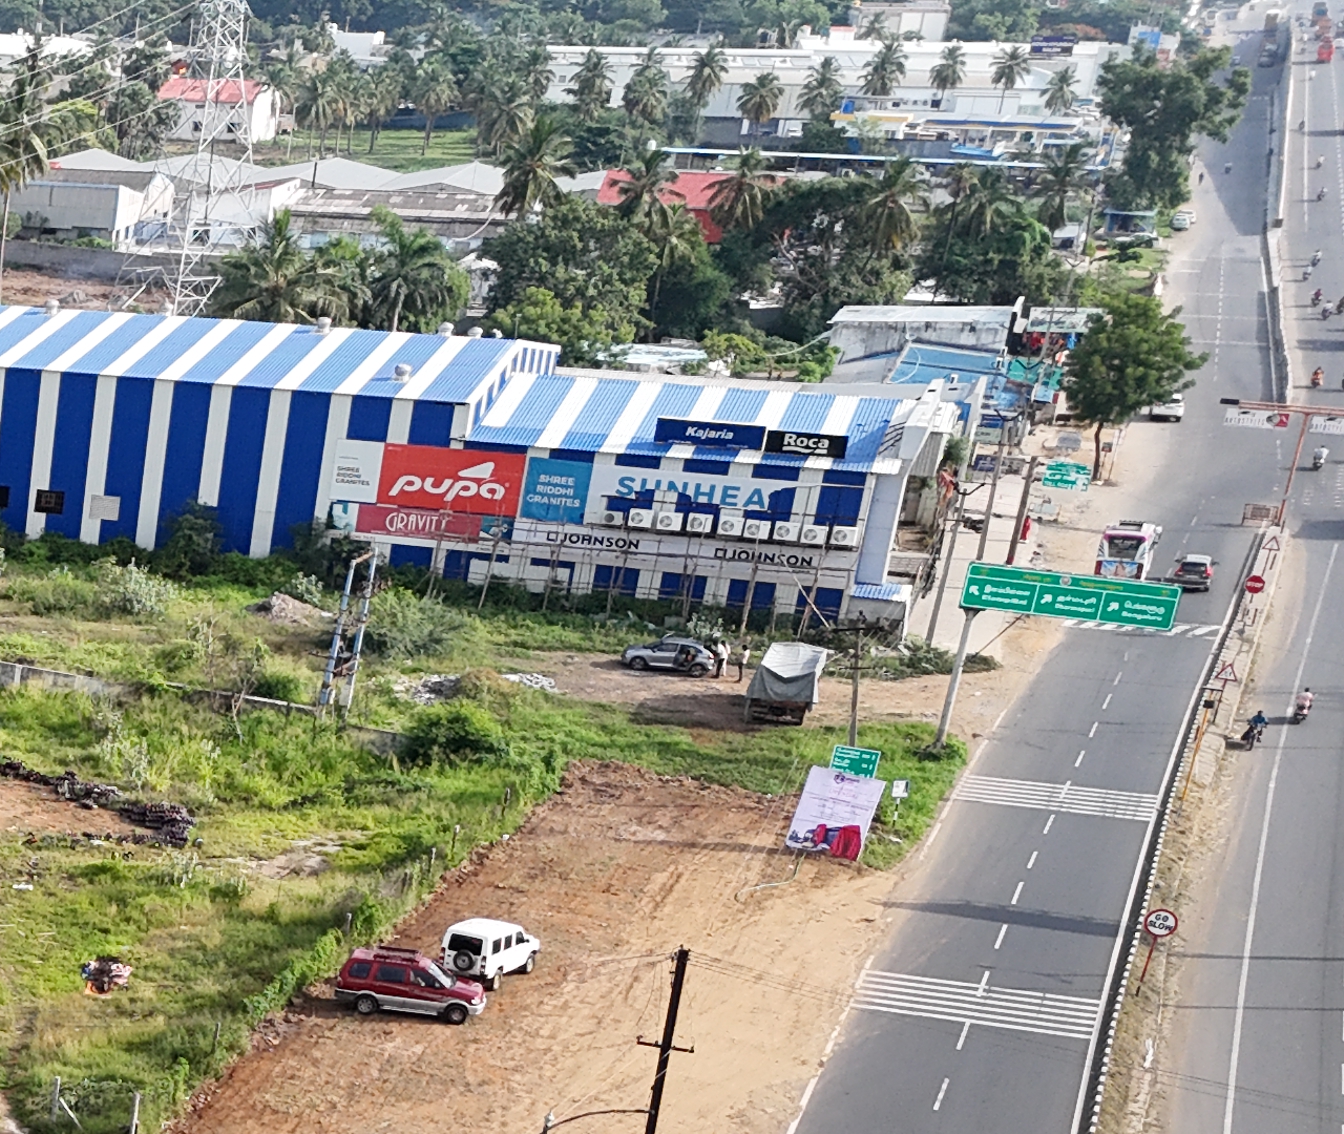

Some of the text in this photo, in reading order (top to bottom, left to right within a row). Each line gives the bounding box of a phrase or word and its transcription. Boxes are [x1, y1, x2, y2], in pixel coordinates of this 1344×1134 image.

[686, 426, 734, 440] Kajaria
[783, 433, 830, 449] Roca
[538, 474, 576, 486] SHREE
[388, 475, 506, 501] pupa
[536, 484, 574, 496] RIDDHI
[526, 494, 581, 508] GRANITES
[563, 532, 640, 550] JOHNSON
[728, 548, 813, 567] JOHNSON
[1155, 914, 1169, 922] GO
[1148, 920, 1174, 931] SLOW
